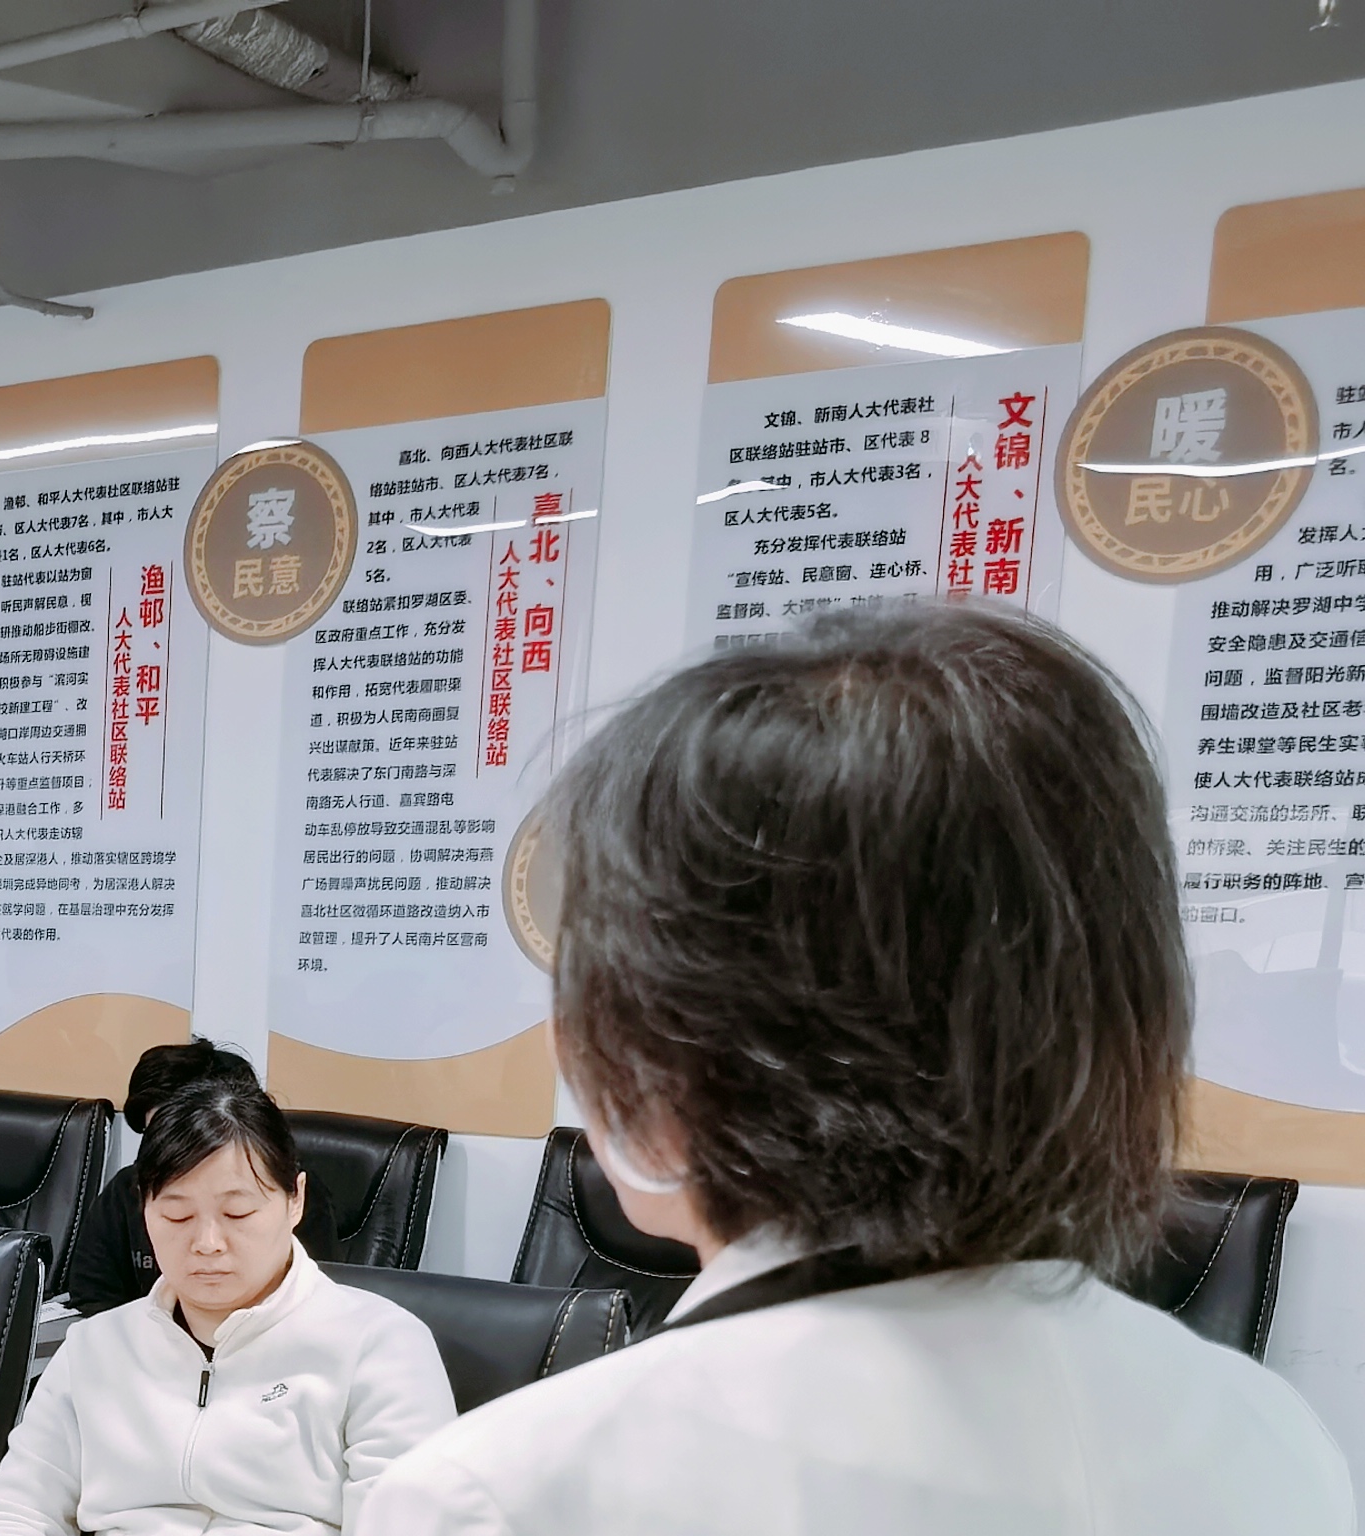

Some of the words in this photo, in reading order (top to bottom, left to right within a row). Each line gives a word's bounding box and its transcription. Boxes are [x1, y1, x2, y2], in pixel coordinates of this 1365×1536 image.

[1149, 388, 1228, 464] 暖
[246, 487, 296, 550] 察
[1124, 476, 1230, 526] 民心
[754, 528, 907, 555] 充分发挥代表联络站
[1297, 524, 1365, 544] 发挥人
[232, 554, 302, 600] 民意
[365, 567, 391, 583] 5名。
[485, 540, 520, 767] 人大代表社区联络站
[107, 607, 133, 811] 人大代表社区联络站
